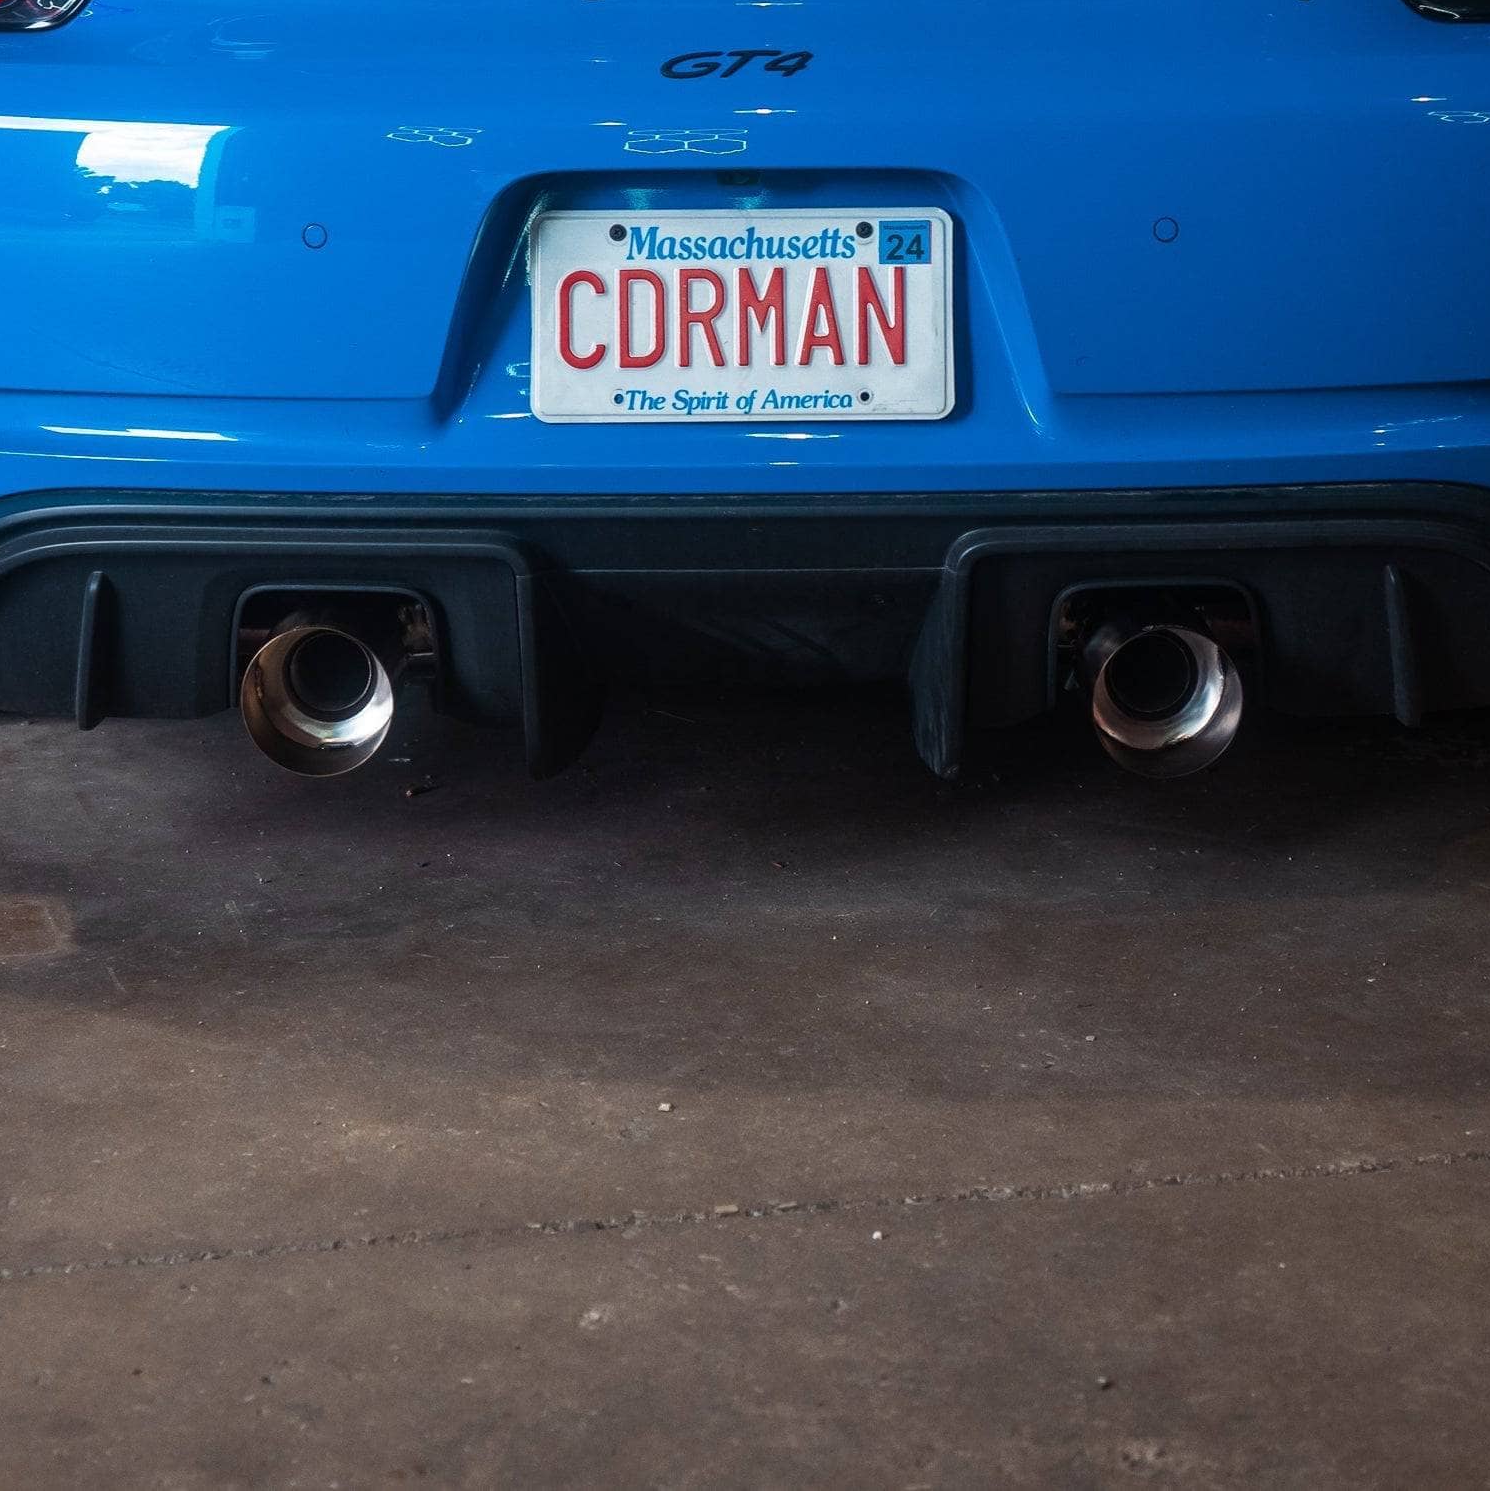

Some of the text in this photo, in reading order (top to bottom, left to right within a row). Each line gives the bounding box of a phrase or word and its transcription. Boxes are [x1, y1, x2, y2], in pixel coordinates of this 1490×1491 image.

[659, 48, 814, 80] GT4
[626, 225, 857, 261] Massachusetts
[885, 233, 926, 261] 24
[557, 265, 906, 370] CDRMAN
[624, 388, 854, 415] The Spirit of America
